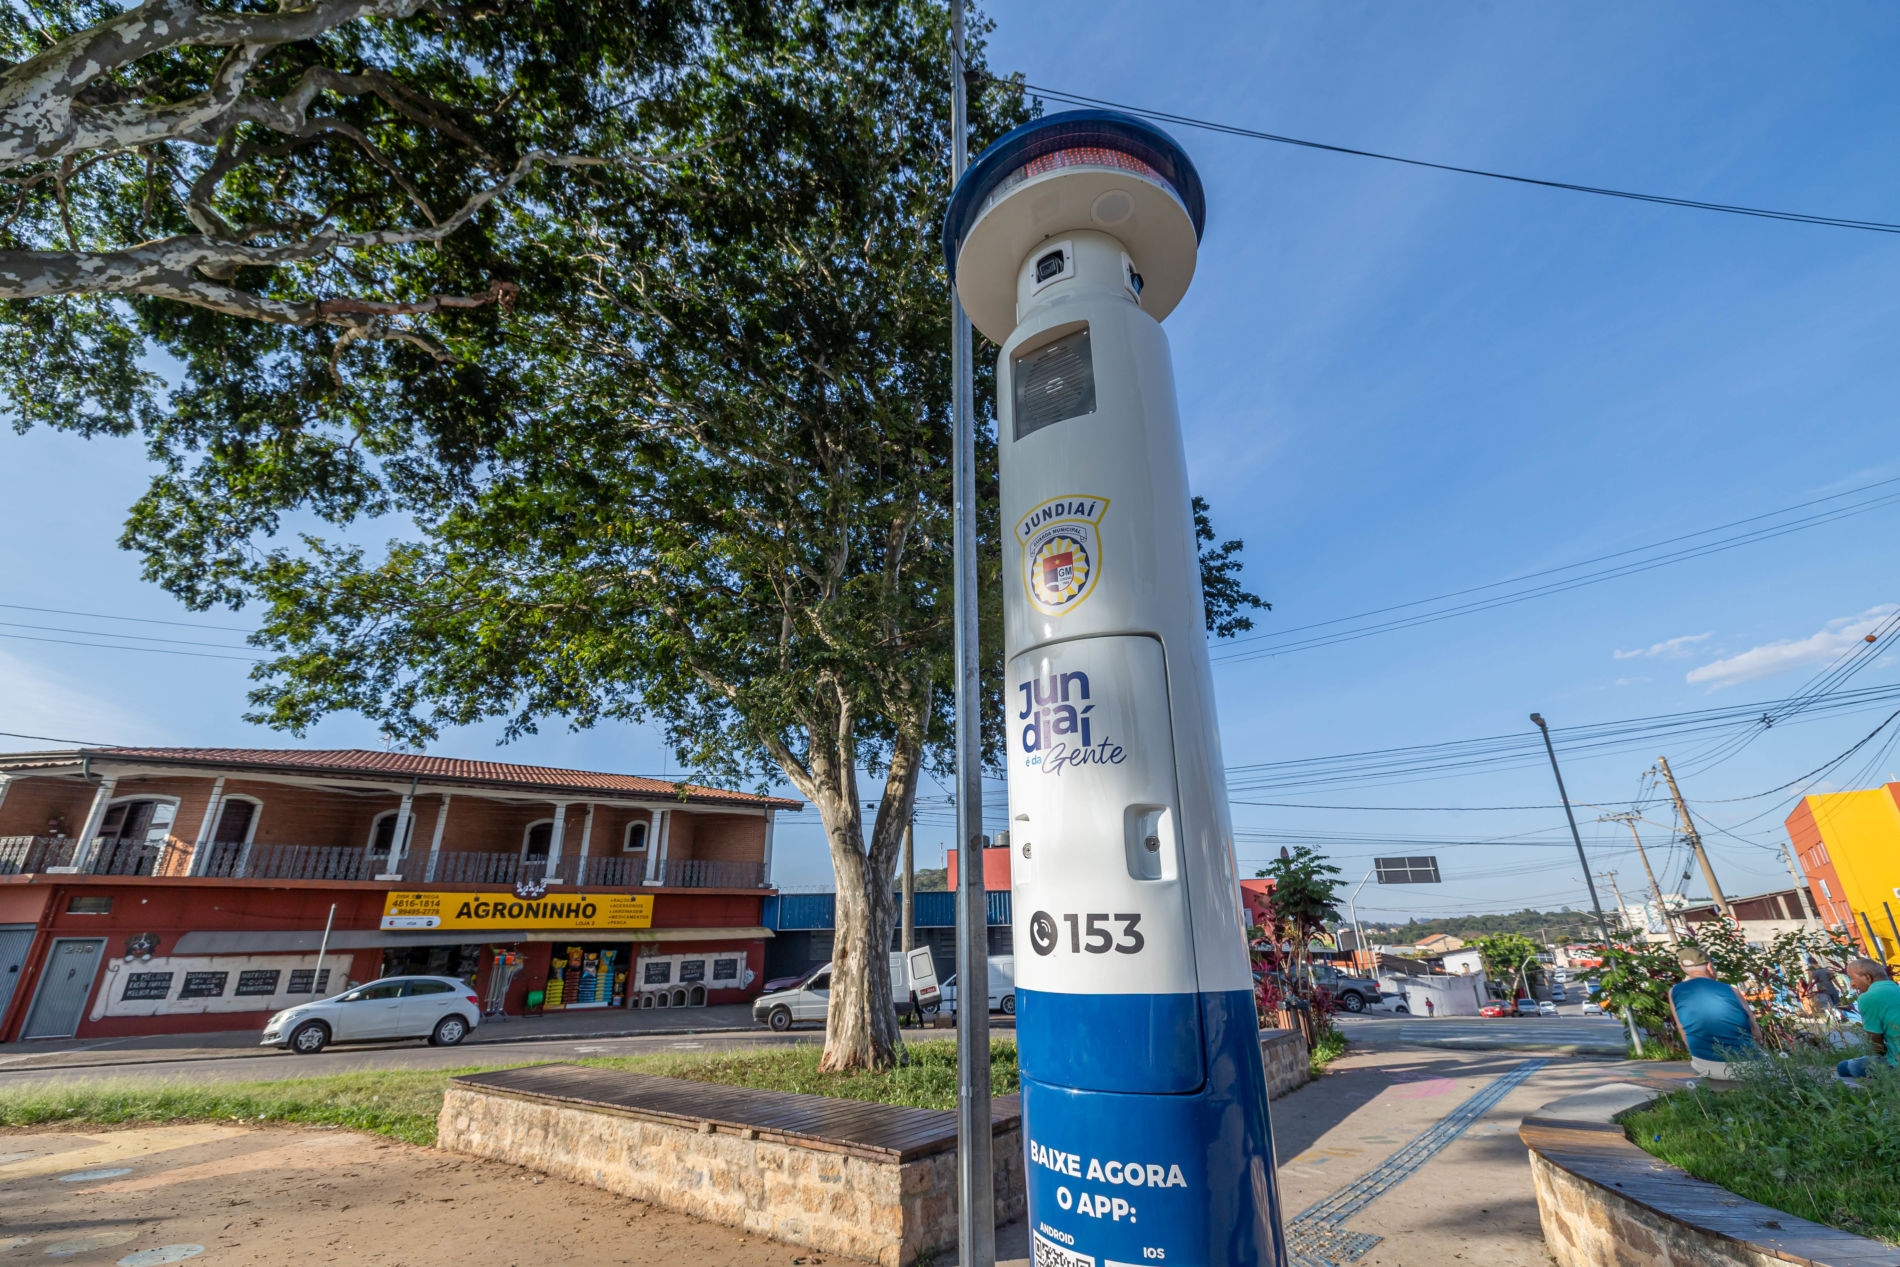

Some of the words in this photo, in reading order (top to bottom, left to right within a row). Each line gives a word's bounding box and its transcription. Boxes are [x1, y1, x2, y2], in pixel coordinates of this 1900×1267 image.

[1025, 501, 1096, 535] JUNDIAÍ
[1058, 566, 1073, 577] GM
[1031, 755, 1042, 766] da
[1042, 736, 1128, 776] Gente
[455, 901, 597, 919] AGRONINHO
[1063, 913, 1145, 954] 153
[1030, 1139, 1082, 1178] BAIXE
[1086, 1158, 1188, 1188] AGORA
[1056, 1186, 1072, 1210] O
[1076, 1192, 1137, 1224] APP:
[1040, 1221, 1075, 1246] ANDROID
[1143, 1246, 1166, 1259] IOS
